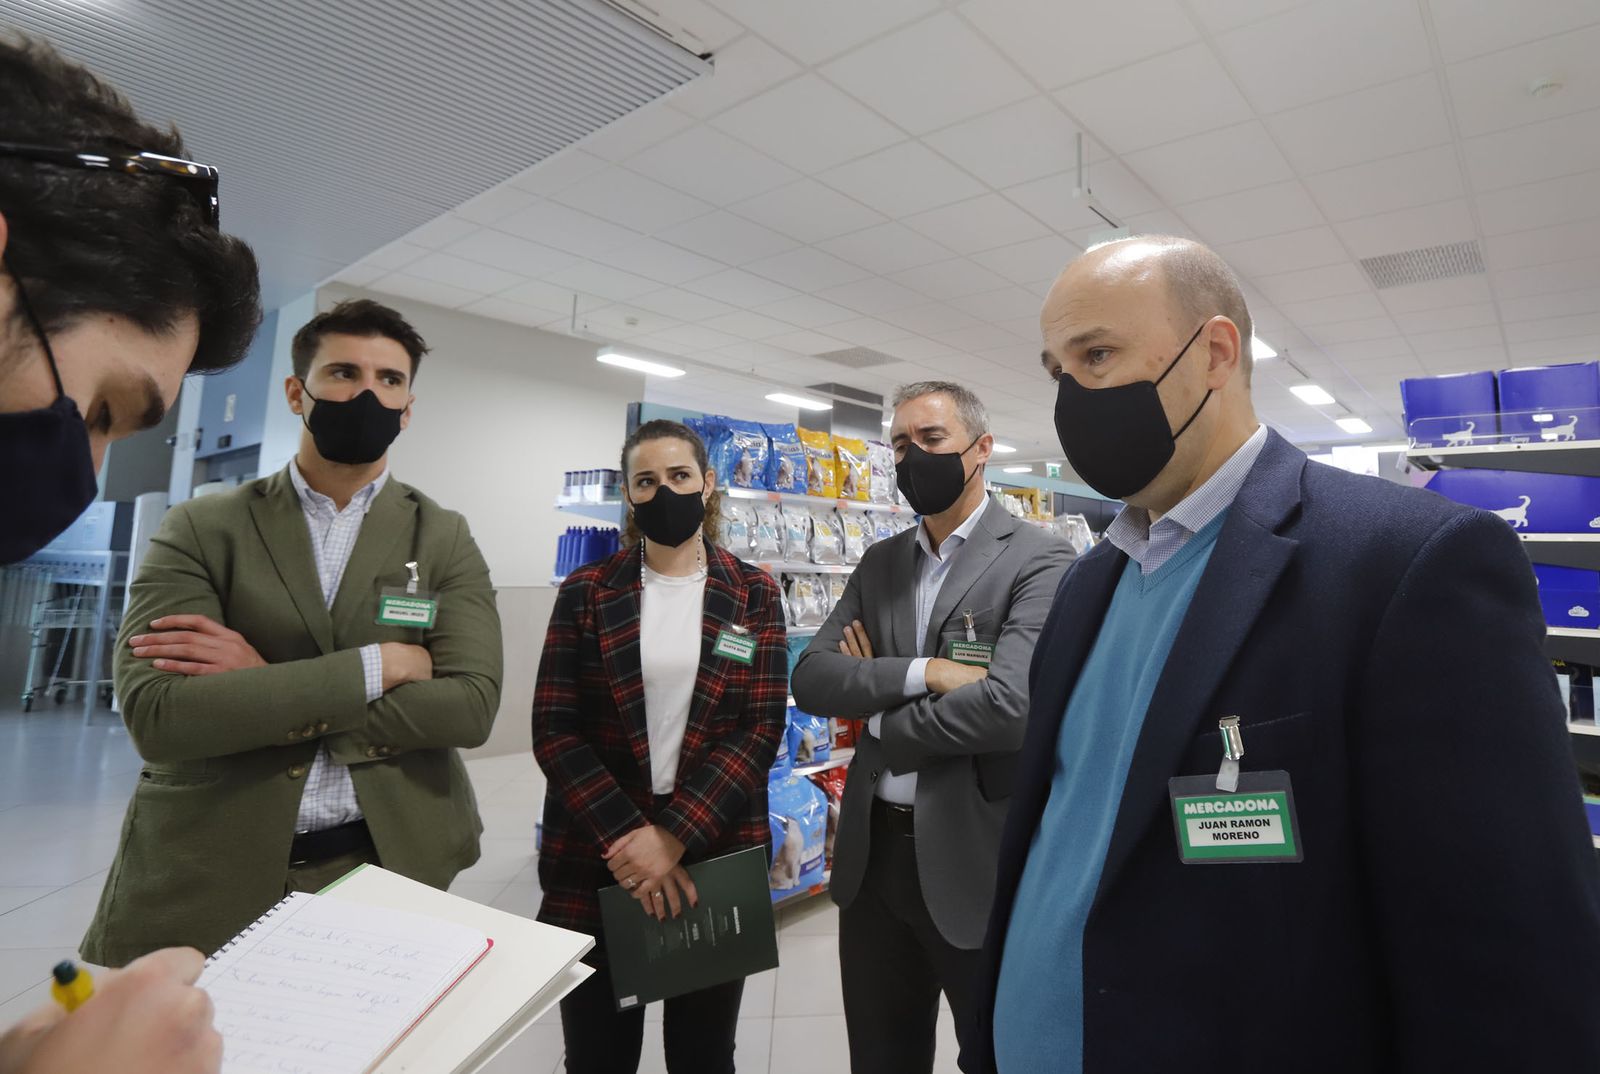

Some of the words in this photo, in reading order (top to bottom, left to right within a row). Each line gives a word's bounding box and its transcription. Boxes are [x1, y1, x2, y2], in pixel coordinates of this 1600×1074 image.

[385, 599, 431, 609] MERCADONA
[722, 634, 753, 647] MERCADONA
[953, 642, 992, 651] MERCADONA
[1184, 799, 1279, 814] MERCADONA
[1198, 821, 1227, 829] JUAN
[1231, 819, 1270, 828] RAMON
[1212, 831, 1259, 840] MORENO
